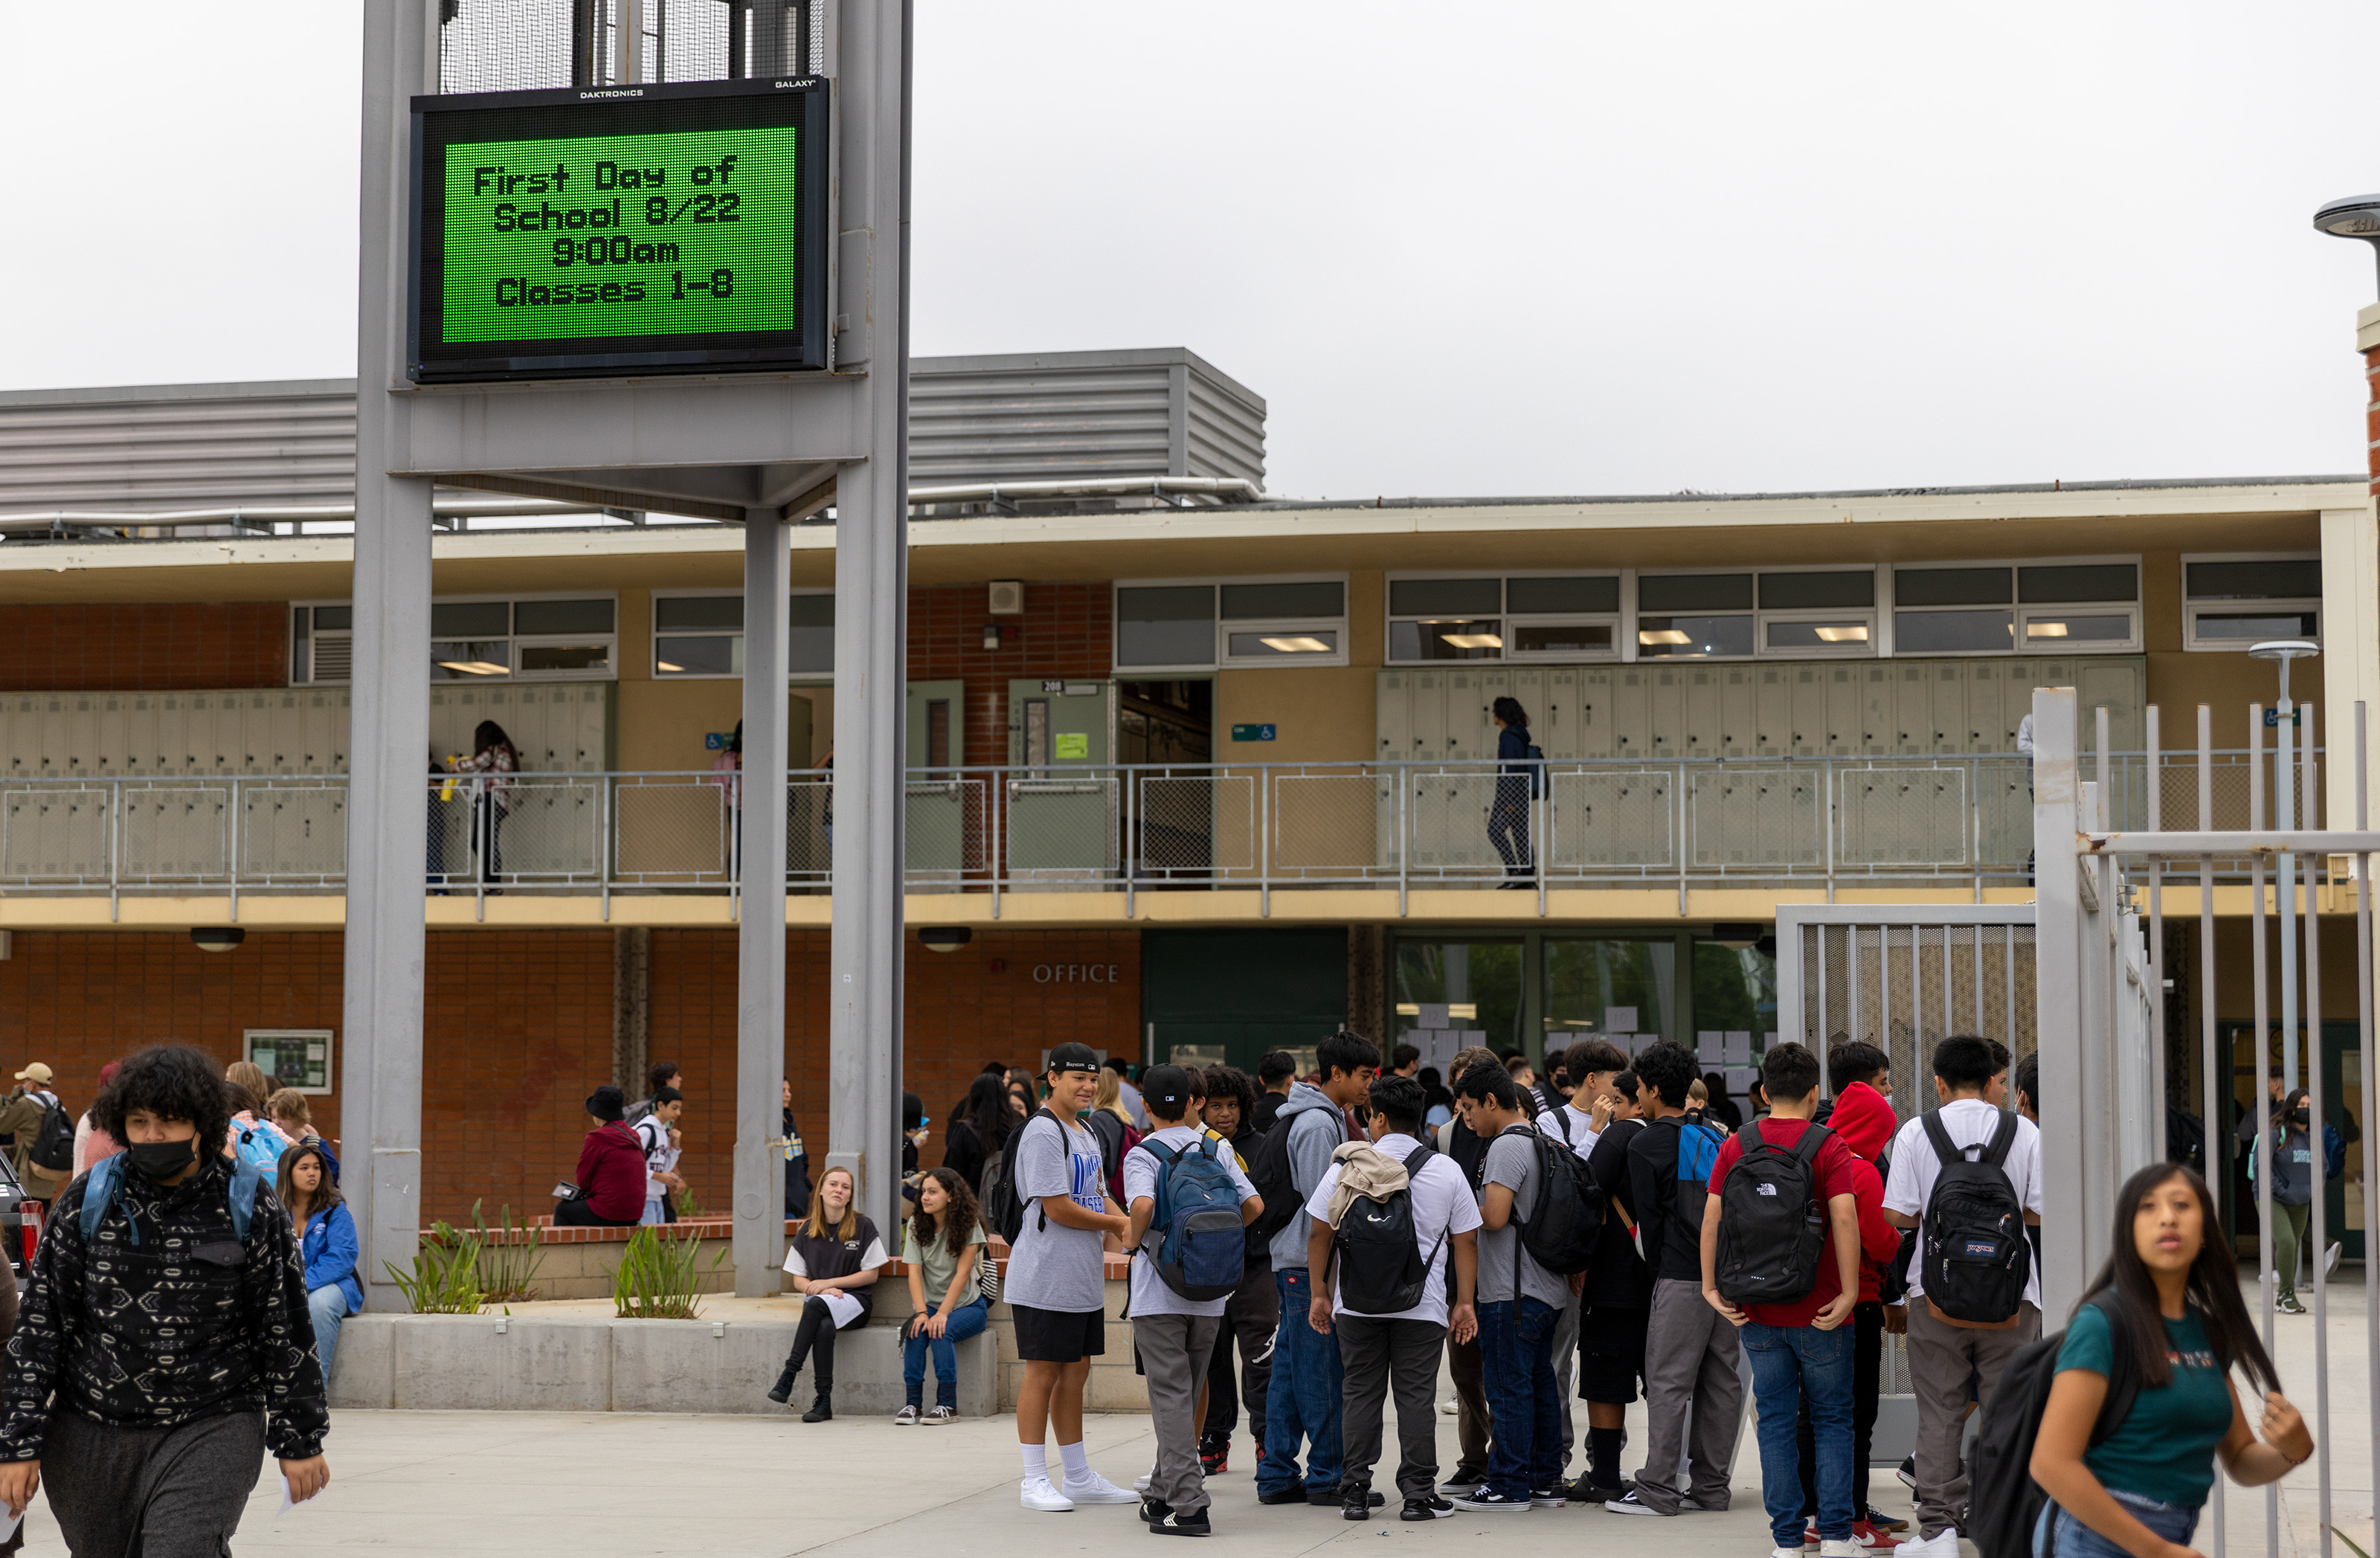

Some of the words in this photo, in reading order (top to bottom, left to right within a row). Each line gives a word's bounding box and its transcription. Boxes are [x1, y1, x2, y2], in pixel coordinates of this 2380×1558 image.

[580, 89, 643, 99] DAKTRONICS
[475, 164, 569, 196] First
[596, 161, 665, 190] Day
[691, 155, 737, 186] of
[494, 199, 620, 232] School
[646, 193, 740, 225] 8/22
[553, 235, 679, 266] 9:00am
[495, 277, 645, 306] Classes
[672, 268, 733, 300] 1-8
[1033, 964, 1119, 983] OFFICE
